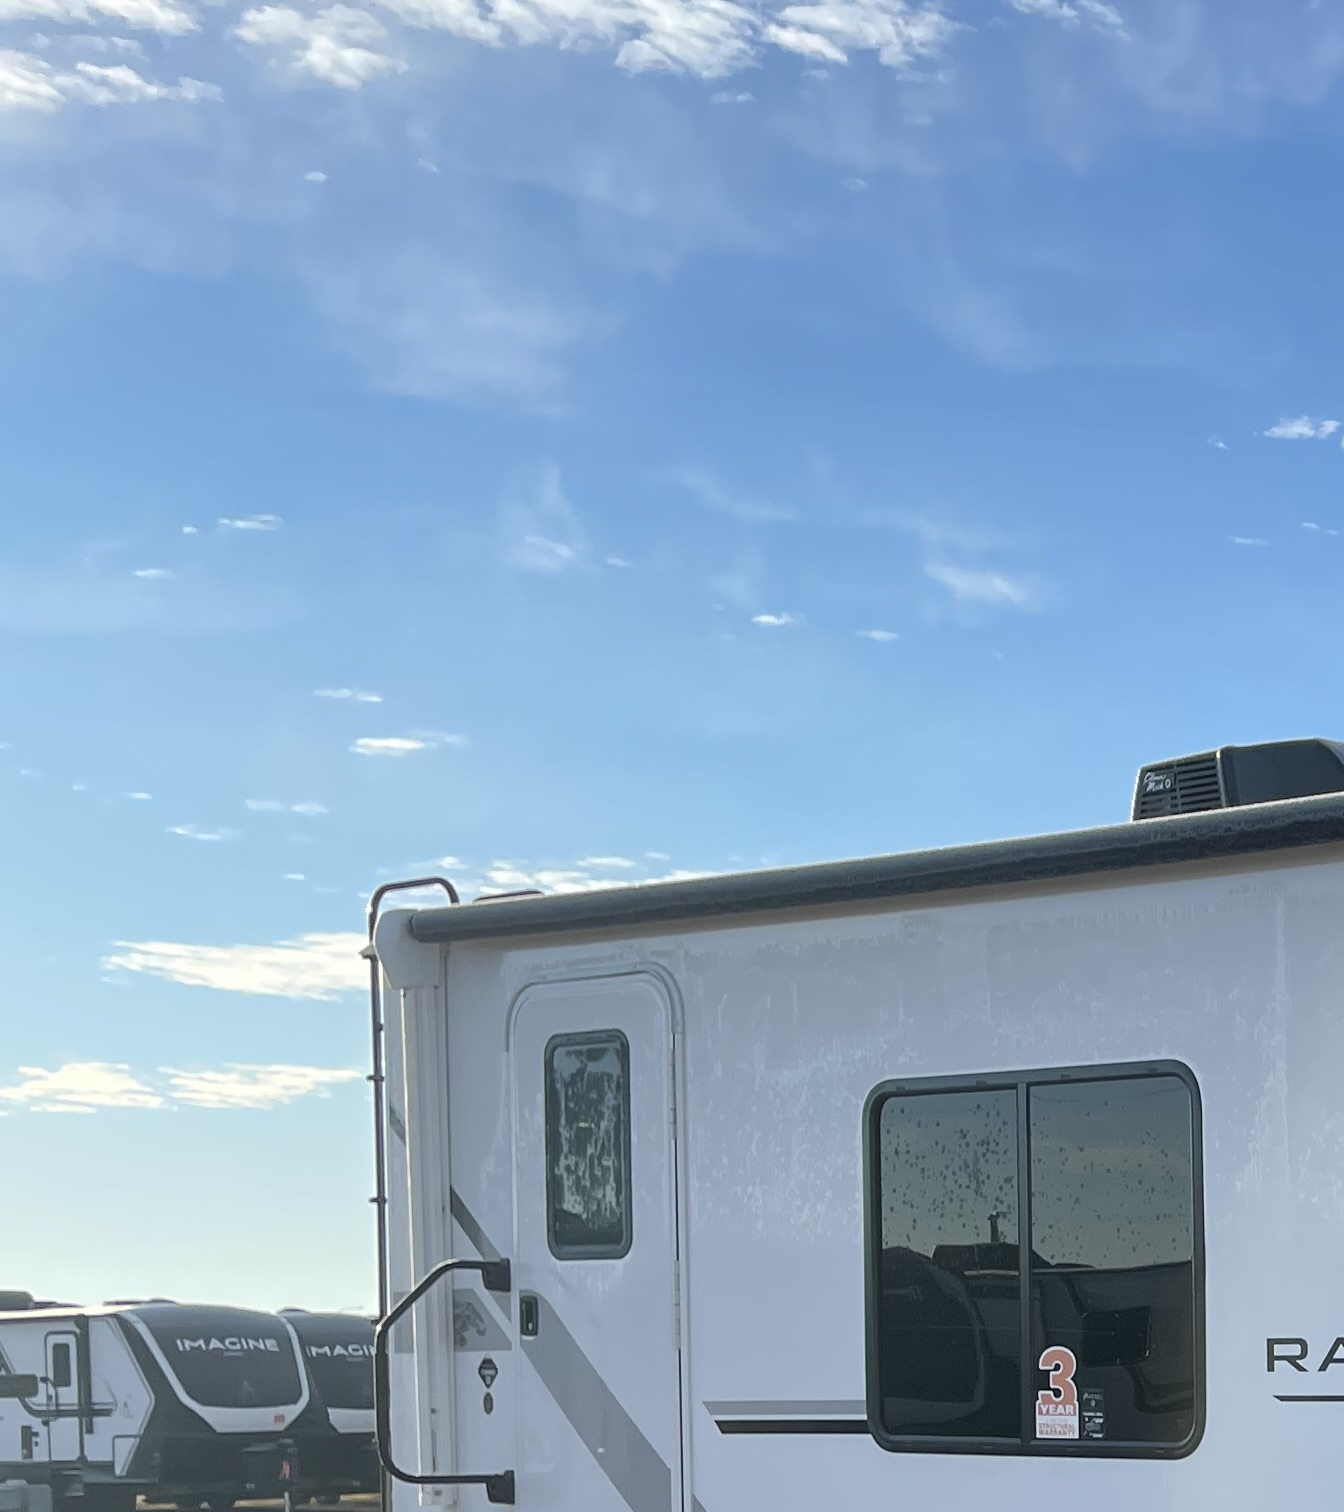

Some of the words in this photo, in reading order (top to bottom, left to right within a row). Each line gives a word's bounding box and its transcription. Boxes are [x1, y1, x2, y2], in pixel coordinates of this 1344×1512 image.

[176, 1337, 280, 1352] IMAGINE
[1038, 1346, 1077, 1404] 3
[1040, 1404, 1075, 1416] YEAR
